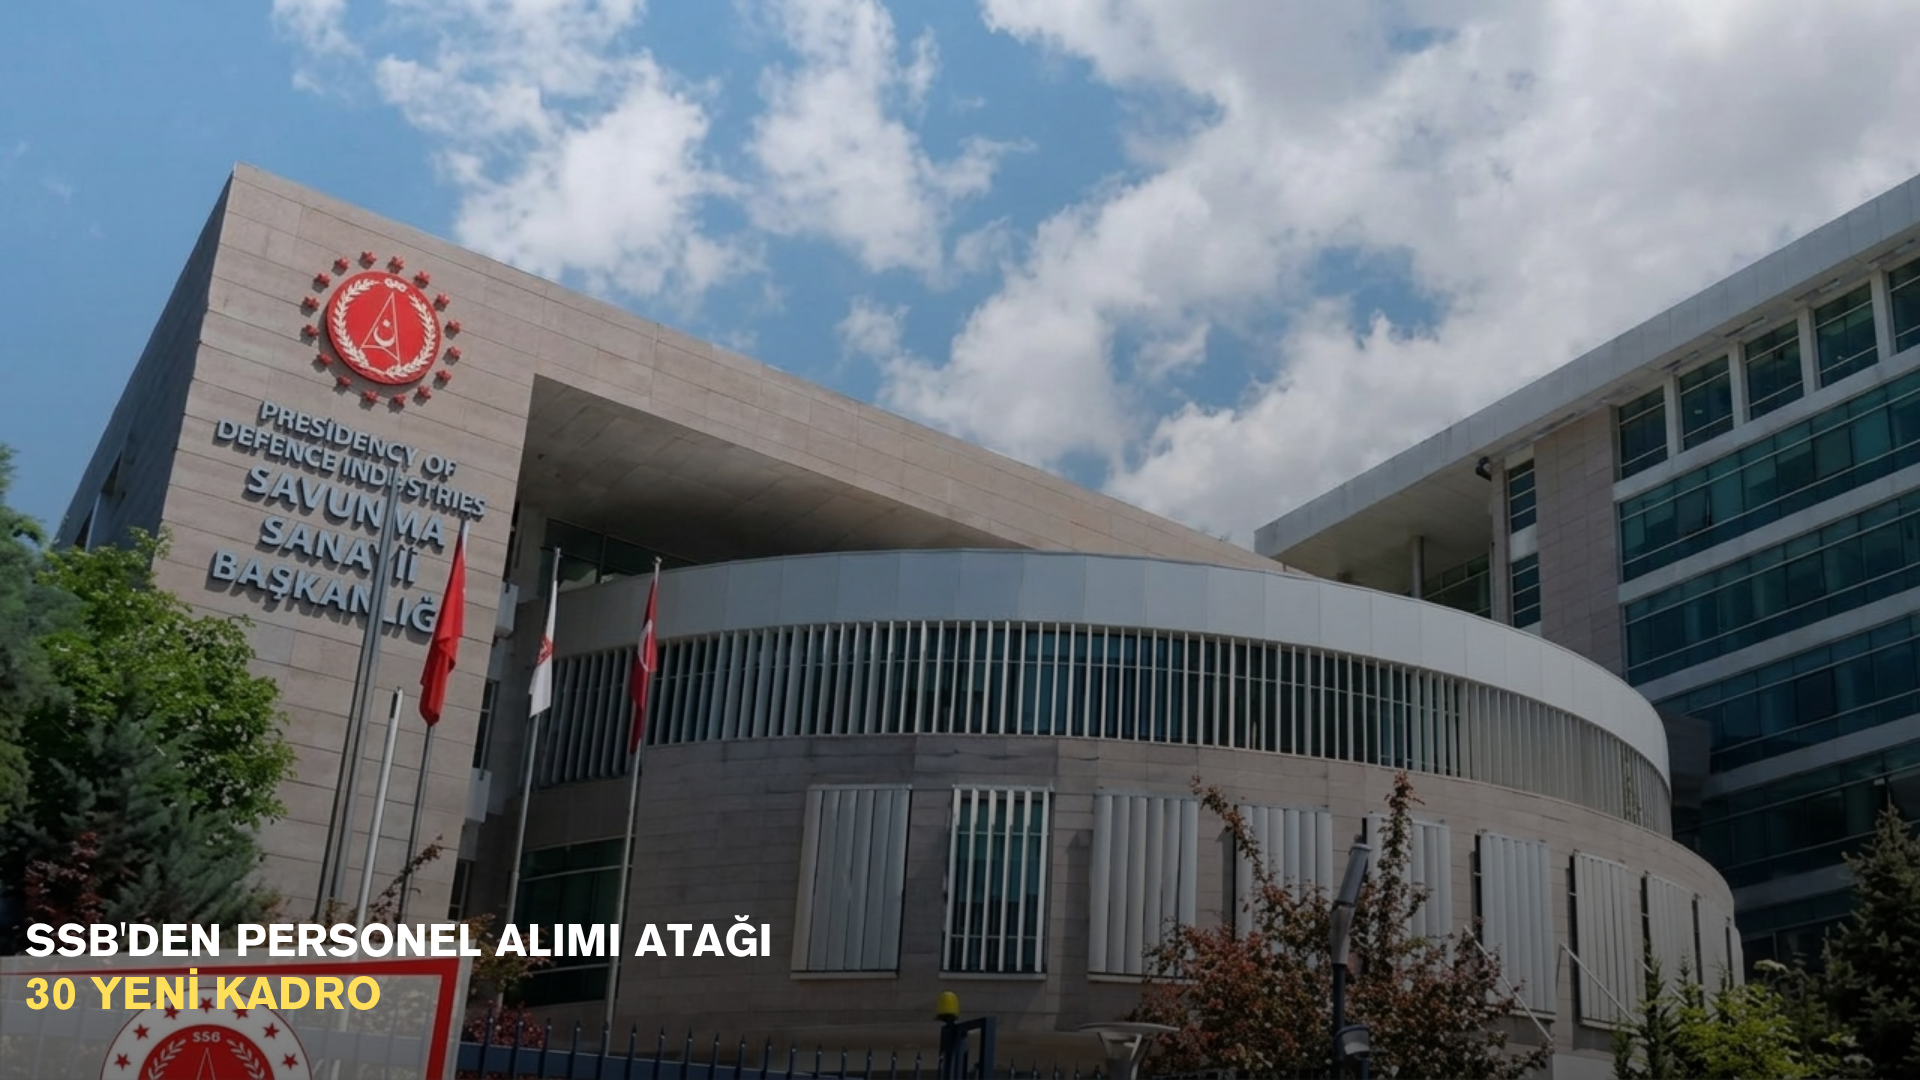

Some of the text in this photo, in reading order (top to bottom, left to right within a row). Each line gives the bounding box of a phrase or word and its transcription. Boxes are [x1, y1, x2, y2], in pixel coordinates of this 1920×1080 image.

[217, 418, 336, 471] DEFENCE
[425, 453, 457, 476] OF
[248, 465, 445, 547] SAVUNMA
[261, 515, 419, 582] SANAİİ
[212, 550, 438, 633] BAŞKANIĞ
